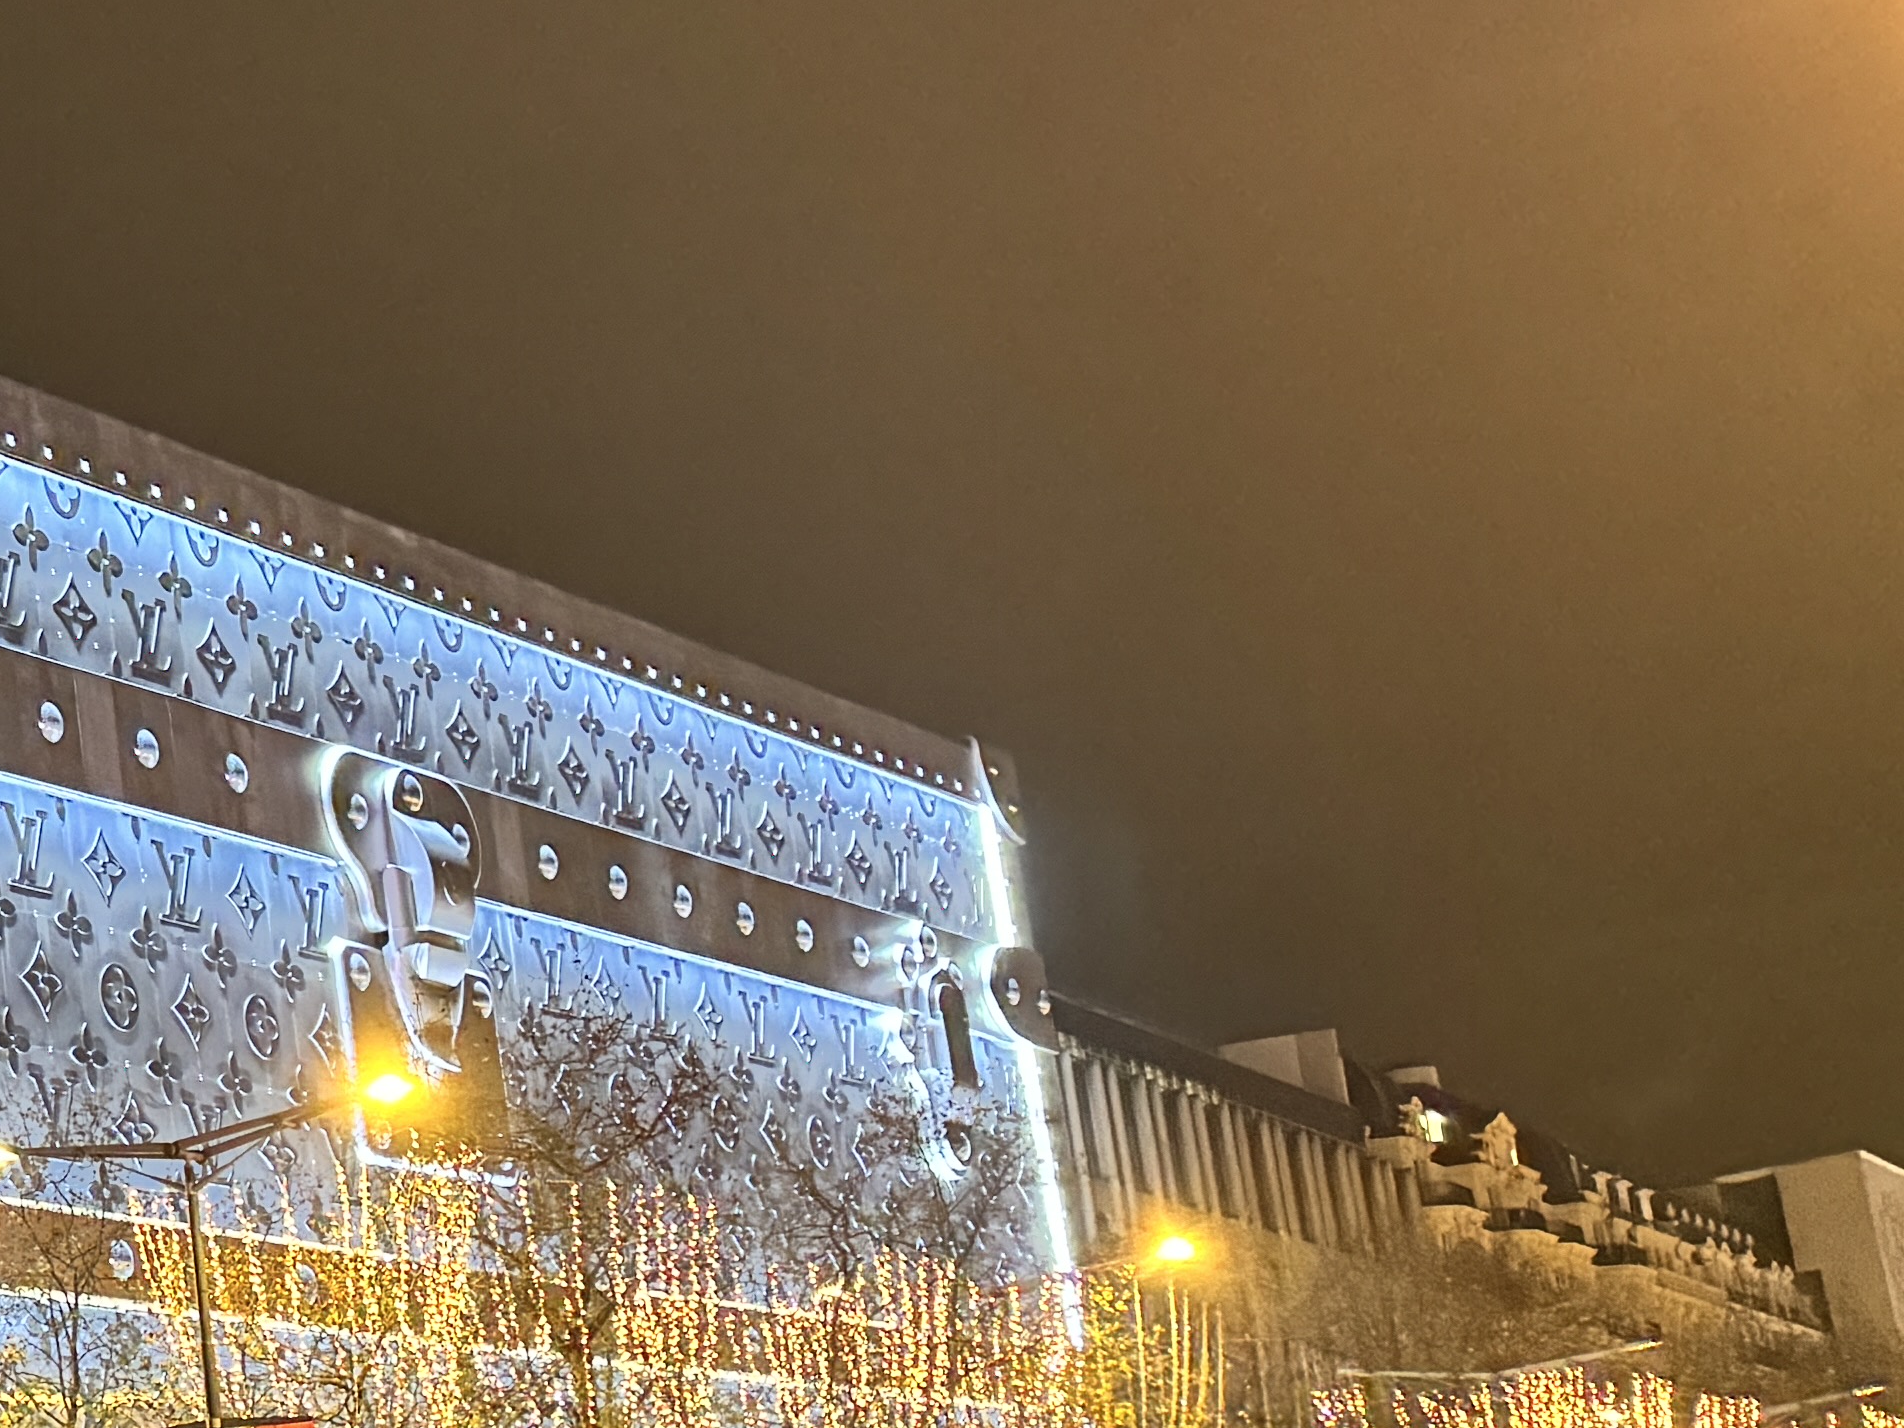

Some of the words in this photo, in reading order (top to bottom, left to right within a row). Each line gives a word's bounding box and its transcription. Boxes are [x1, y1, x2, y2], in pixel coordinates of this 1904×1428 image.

[121, 588, 173, 682] LV
[257, 633, 305, 726] LV
[0, 801, 54, 899] LV
[150, 839, 201, 929] LV
